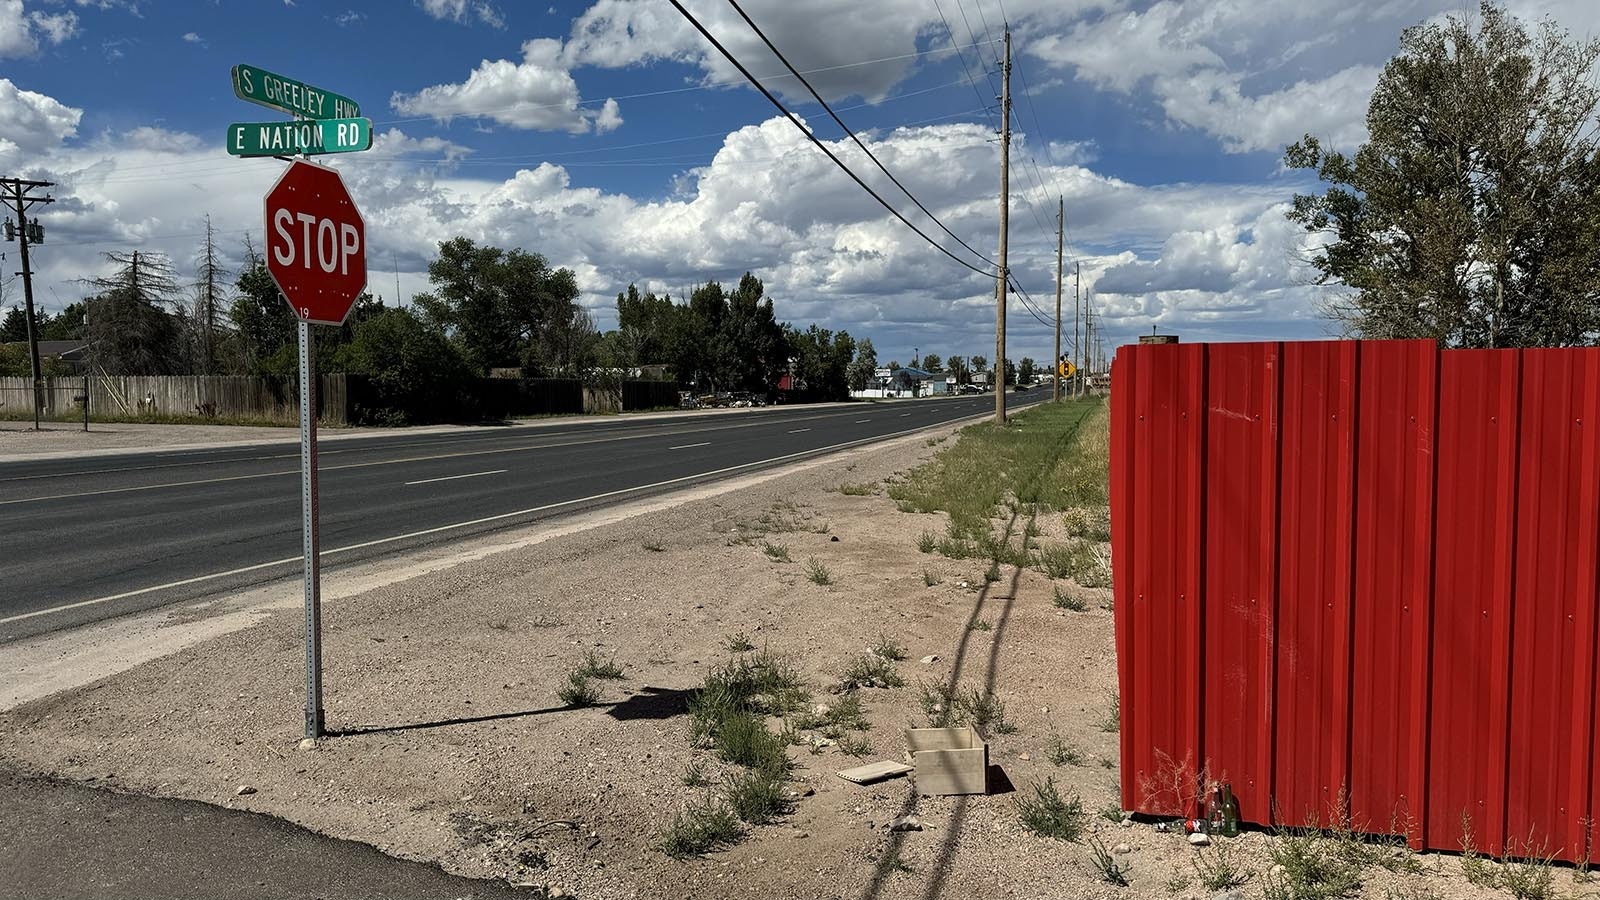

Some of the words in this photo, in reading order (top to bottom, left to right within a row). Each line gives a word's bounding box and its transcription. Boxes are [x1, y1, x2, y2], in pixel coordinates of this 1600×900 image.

[242, 69, 254, 94] S
[264, 75, 325, 115] GREELEY
[335, 99, 358, 118] HWY
[236, 127, 245, 150] E
[259, 124, 323, 149] NATION
[337, 123, 359, 146] RD
[273, 208, 360, 275] STOP
[299, 307, 310, 319] 19
